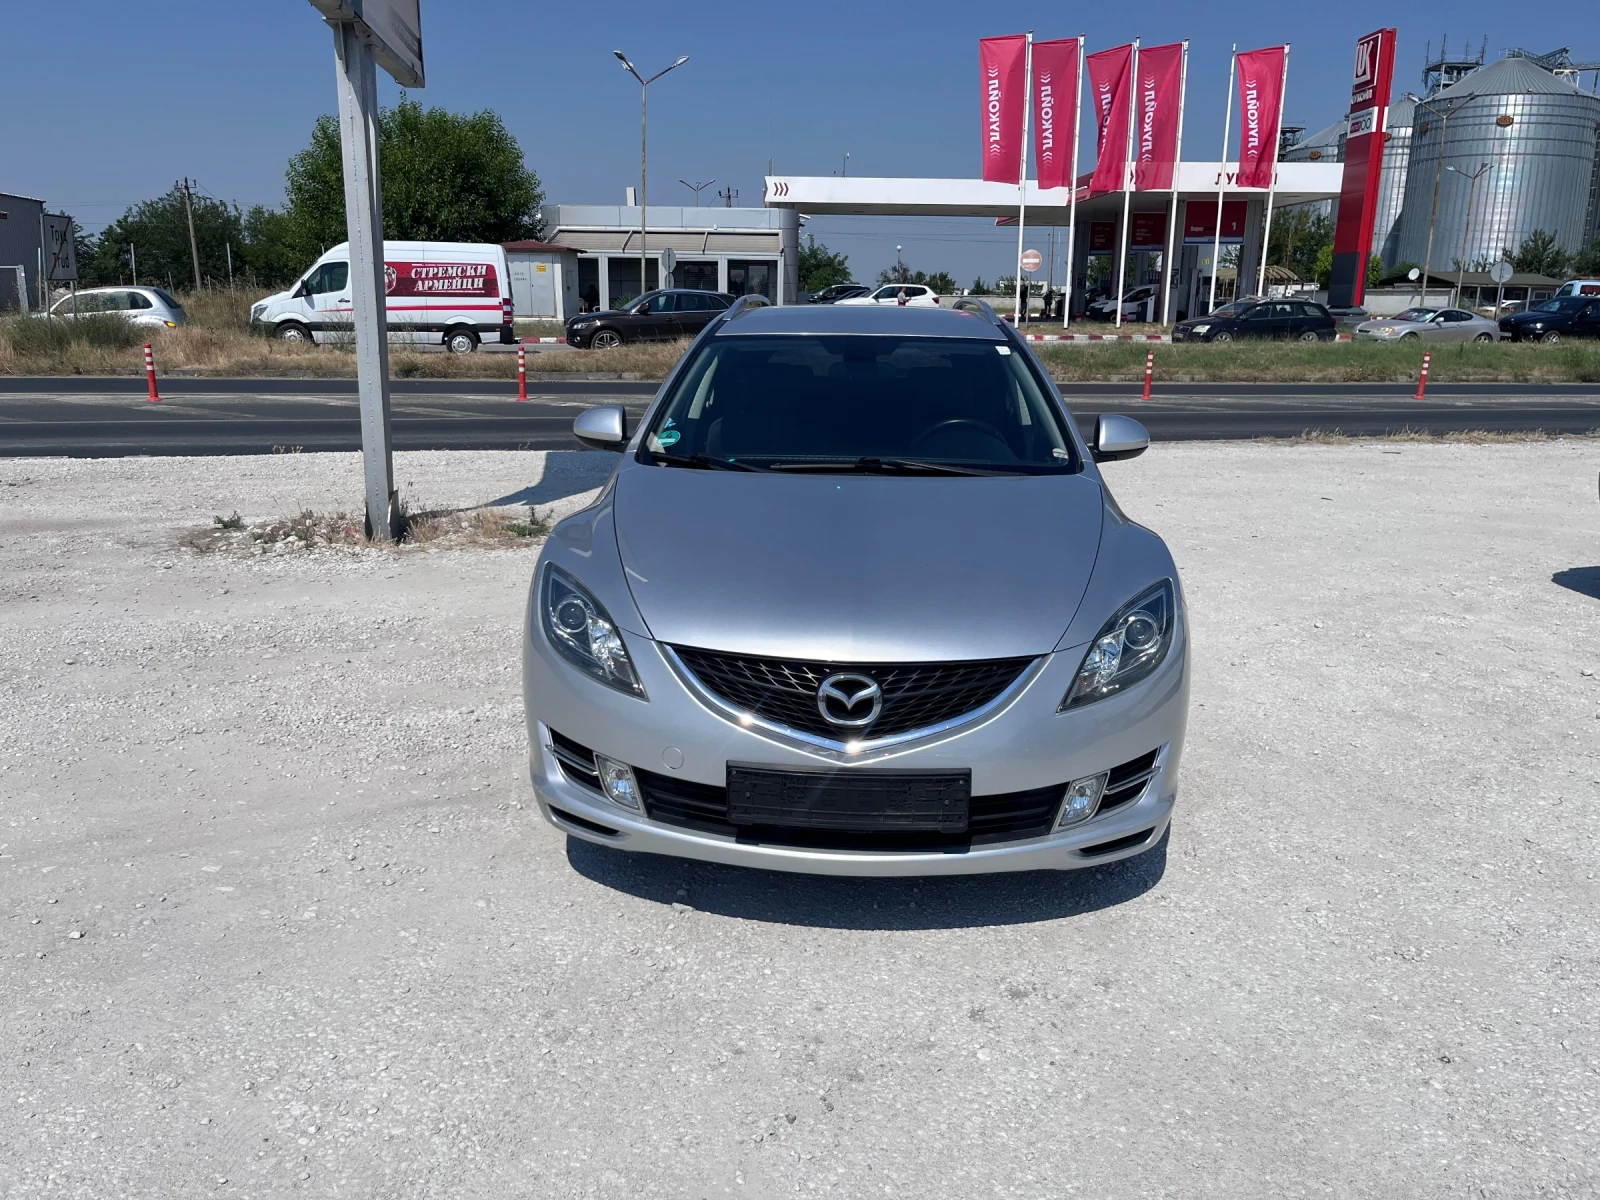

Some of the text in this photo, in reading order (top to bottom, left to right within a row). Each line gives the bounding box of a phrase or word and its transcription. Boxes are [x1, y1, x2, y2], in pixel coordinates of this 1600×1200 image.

[1231, 221, 1237, 231] 1
[52, 252, 70, 268] Trud
[411, 265, 487, 279] СТРЕМСКИ
[414, 277, 484, 292] АРМЕЙЦИ
